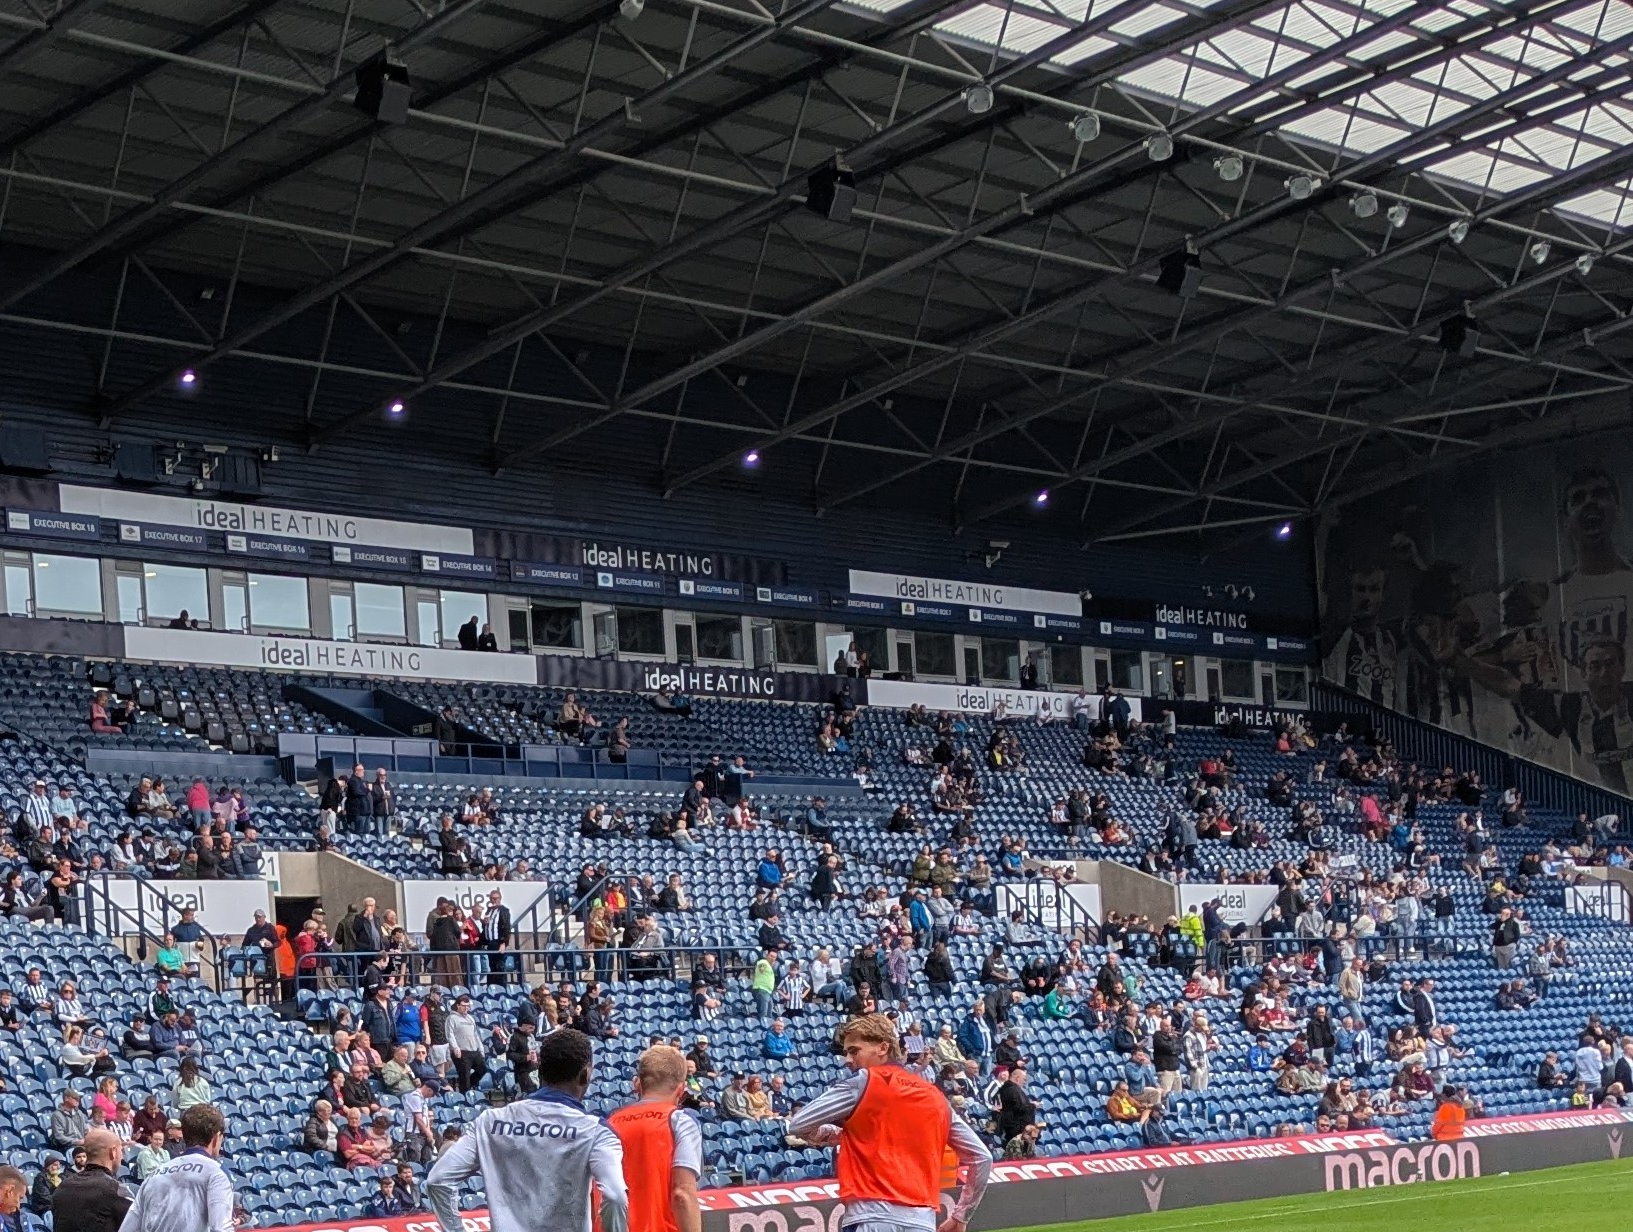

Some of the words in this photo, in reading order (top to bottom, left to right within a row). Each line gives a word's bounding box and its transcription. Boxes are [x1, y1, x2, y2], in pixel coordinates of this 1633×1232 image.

[197, 503, 246, 530] ideal
[253, 510, 357, 539] HEATING
[582, 543, 622, 568] ideal
[627, 550, 712, 575] HEATING
[896, 578, 929, 598] ideal
[933, 584, 1003, 605] HEATING
[1156, 604, 1184, 624] ideal
[1186, 611, 1247, 629] HEATING
[261, 640, 310, 666] ideal
[317, 646, 421, 671] HEATING
[645, 667, 685, 691] ideal
[689, 672, 774, 695] HEATING
[956, 689, 989, 710] ideal
[149, 886, 205, 912] ideal
[490, 1119, 577, 1140] macron
[613, 1110, 664, 1124] macron
[1324, 1141, 1481, 1192] macron
